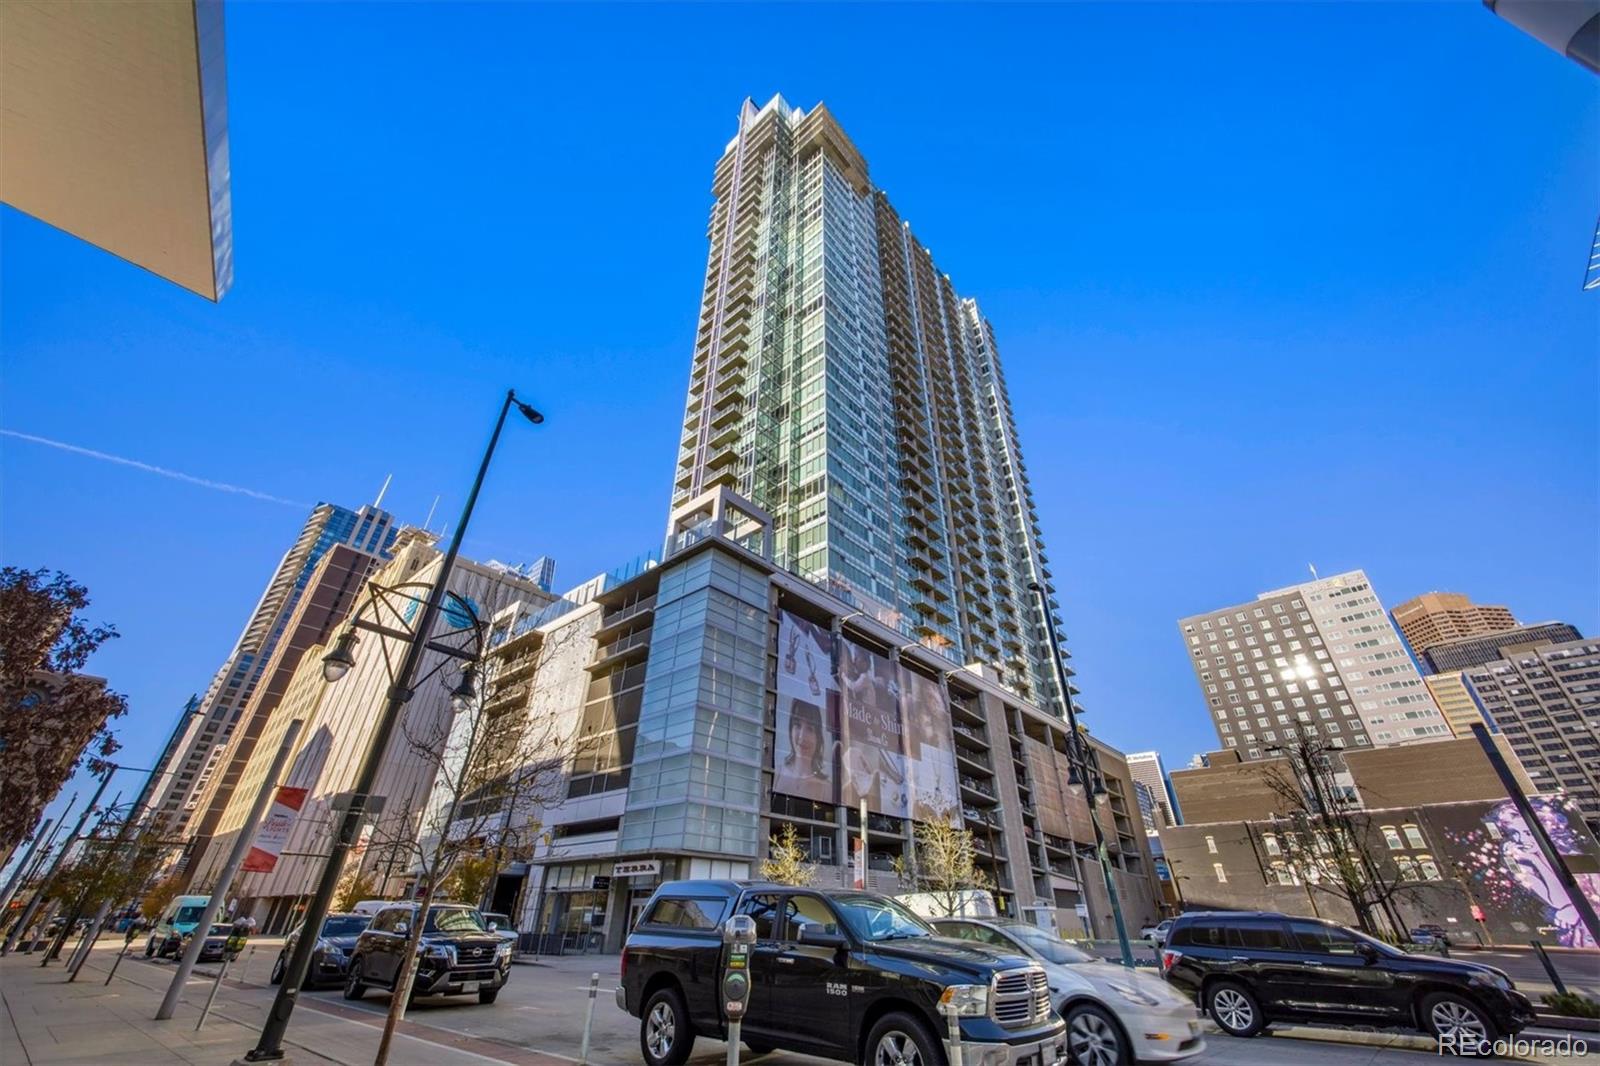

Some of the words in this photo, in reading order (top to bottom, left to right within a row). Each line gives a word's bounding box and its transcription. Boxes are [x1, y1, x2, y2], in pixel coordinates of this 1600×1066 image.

[615, 864, 655, 873] TERRA
[827, 982, 848, 990] RAM
[826, 988, 848, 996] 1500
